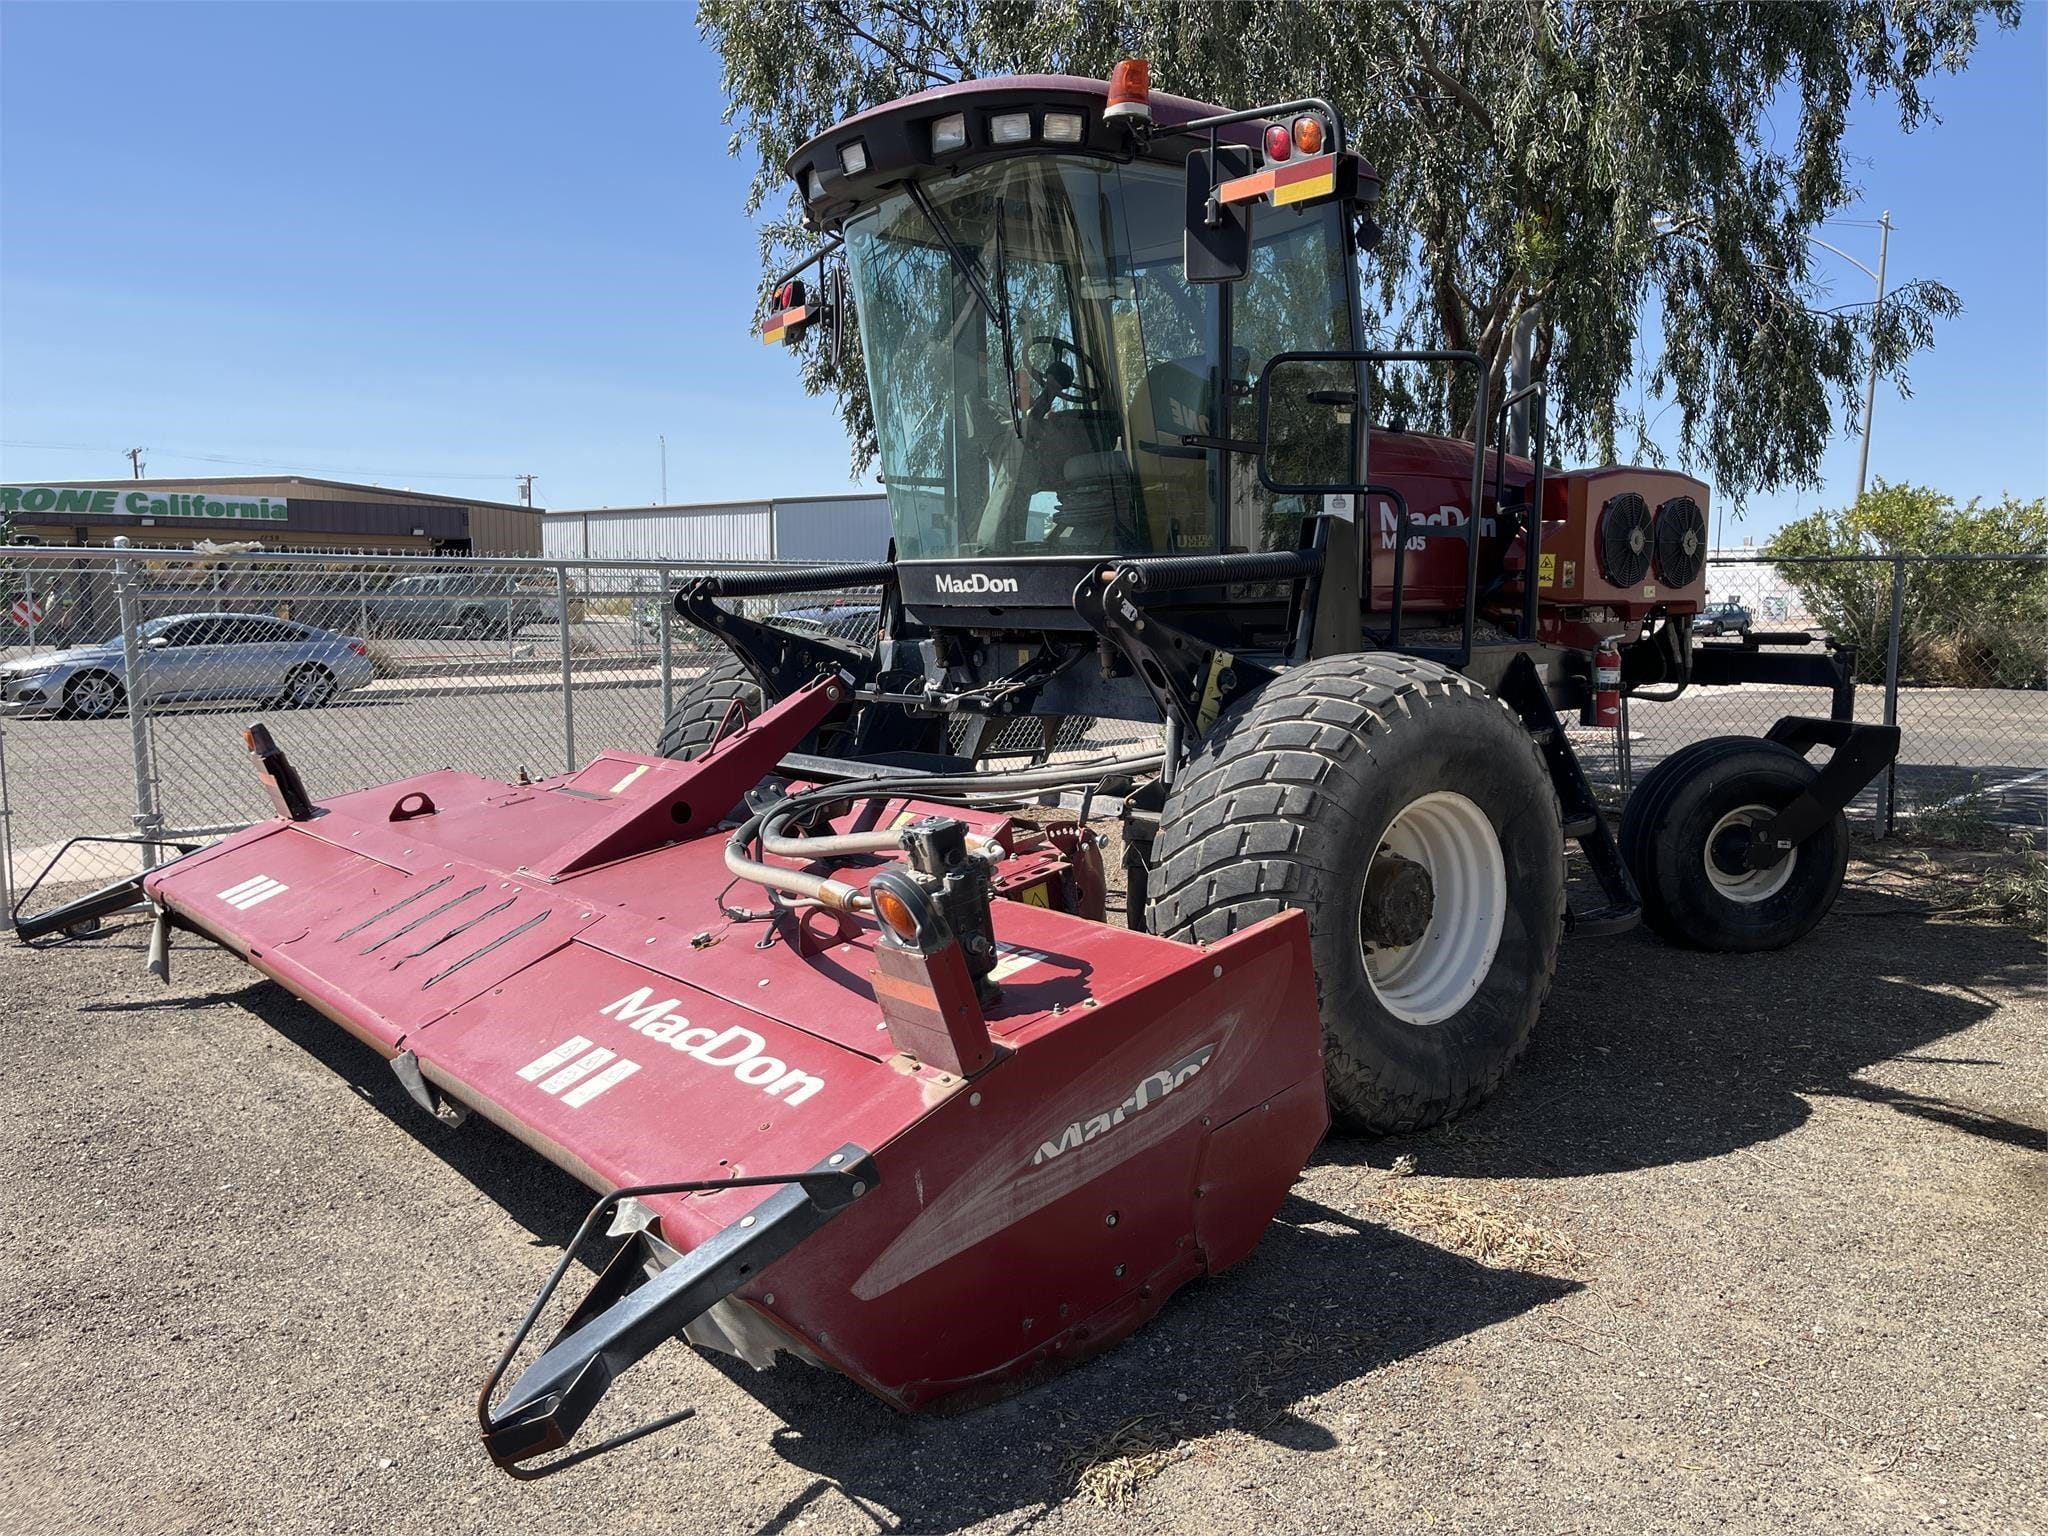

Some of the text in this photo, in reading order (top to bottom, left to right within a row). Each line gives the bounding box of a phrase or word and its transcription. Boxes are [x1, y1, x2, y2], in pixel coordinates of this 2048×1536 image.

[125, 492, 288, 519] California
[1381, 532, 1426, 551] M05
[935, 573, 1018, 593] MacDon
[599, 986, 825, 1107] MacDon
